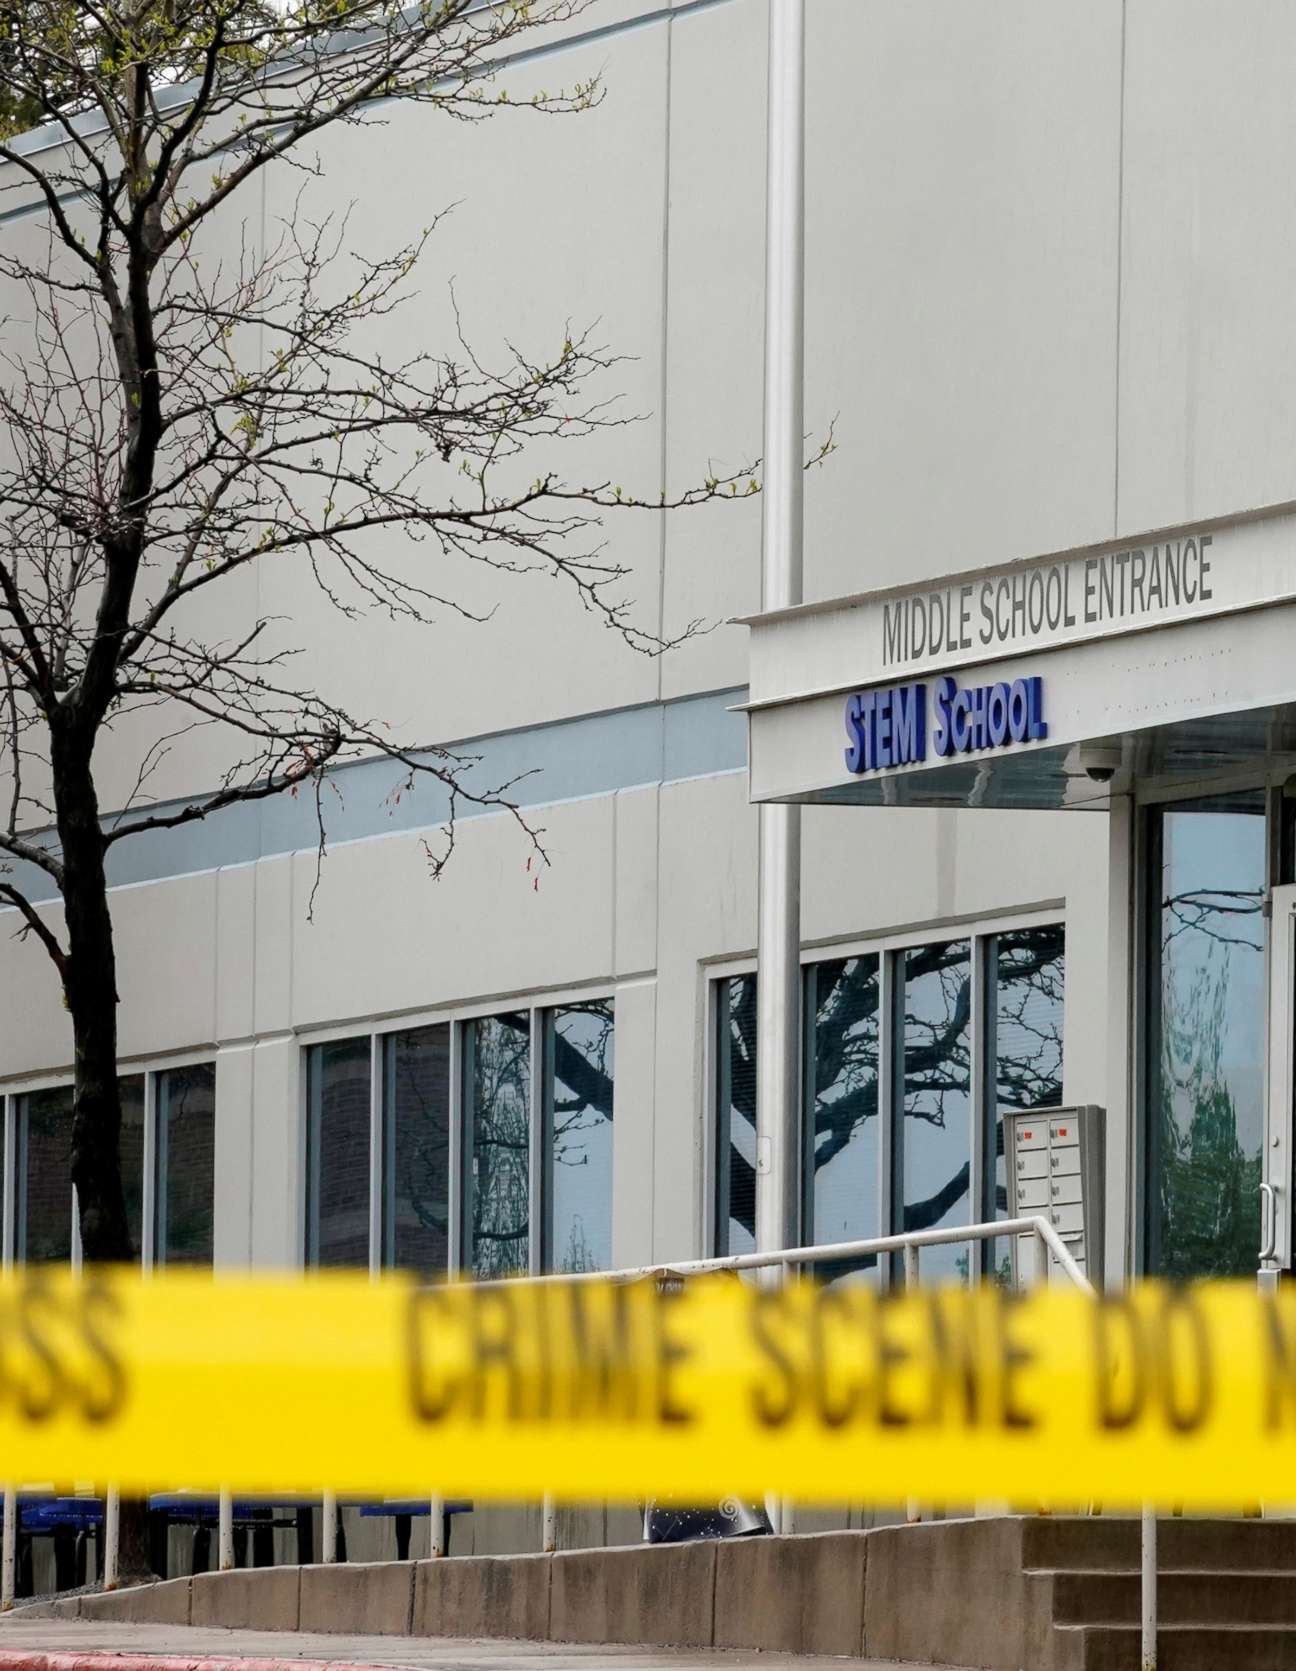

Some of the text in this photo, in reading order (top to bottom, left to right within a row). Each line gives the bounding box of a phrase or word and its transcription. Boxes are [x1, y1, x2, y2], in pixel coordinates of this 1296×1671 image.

[882, 535, 1213, 666] MIDDLE SCHOOL ENTRANCE
[844, 683, 926, 773] STEM
[405, 1280, 698, 1428] CRIME
[750, 1283, 1040, 1433] SCENE
[1100, 1288, 1214, 1437] DO
